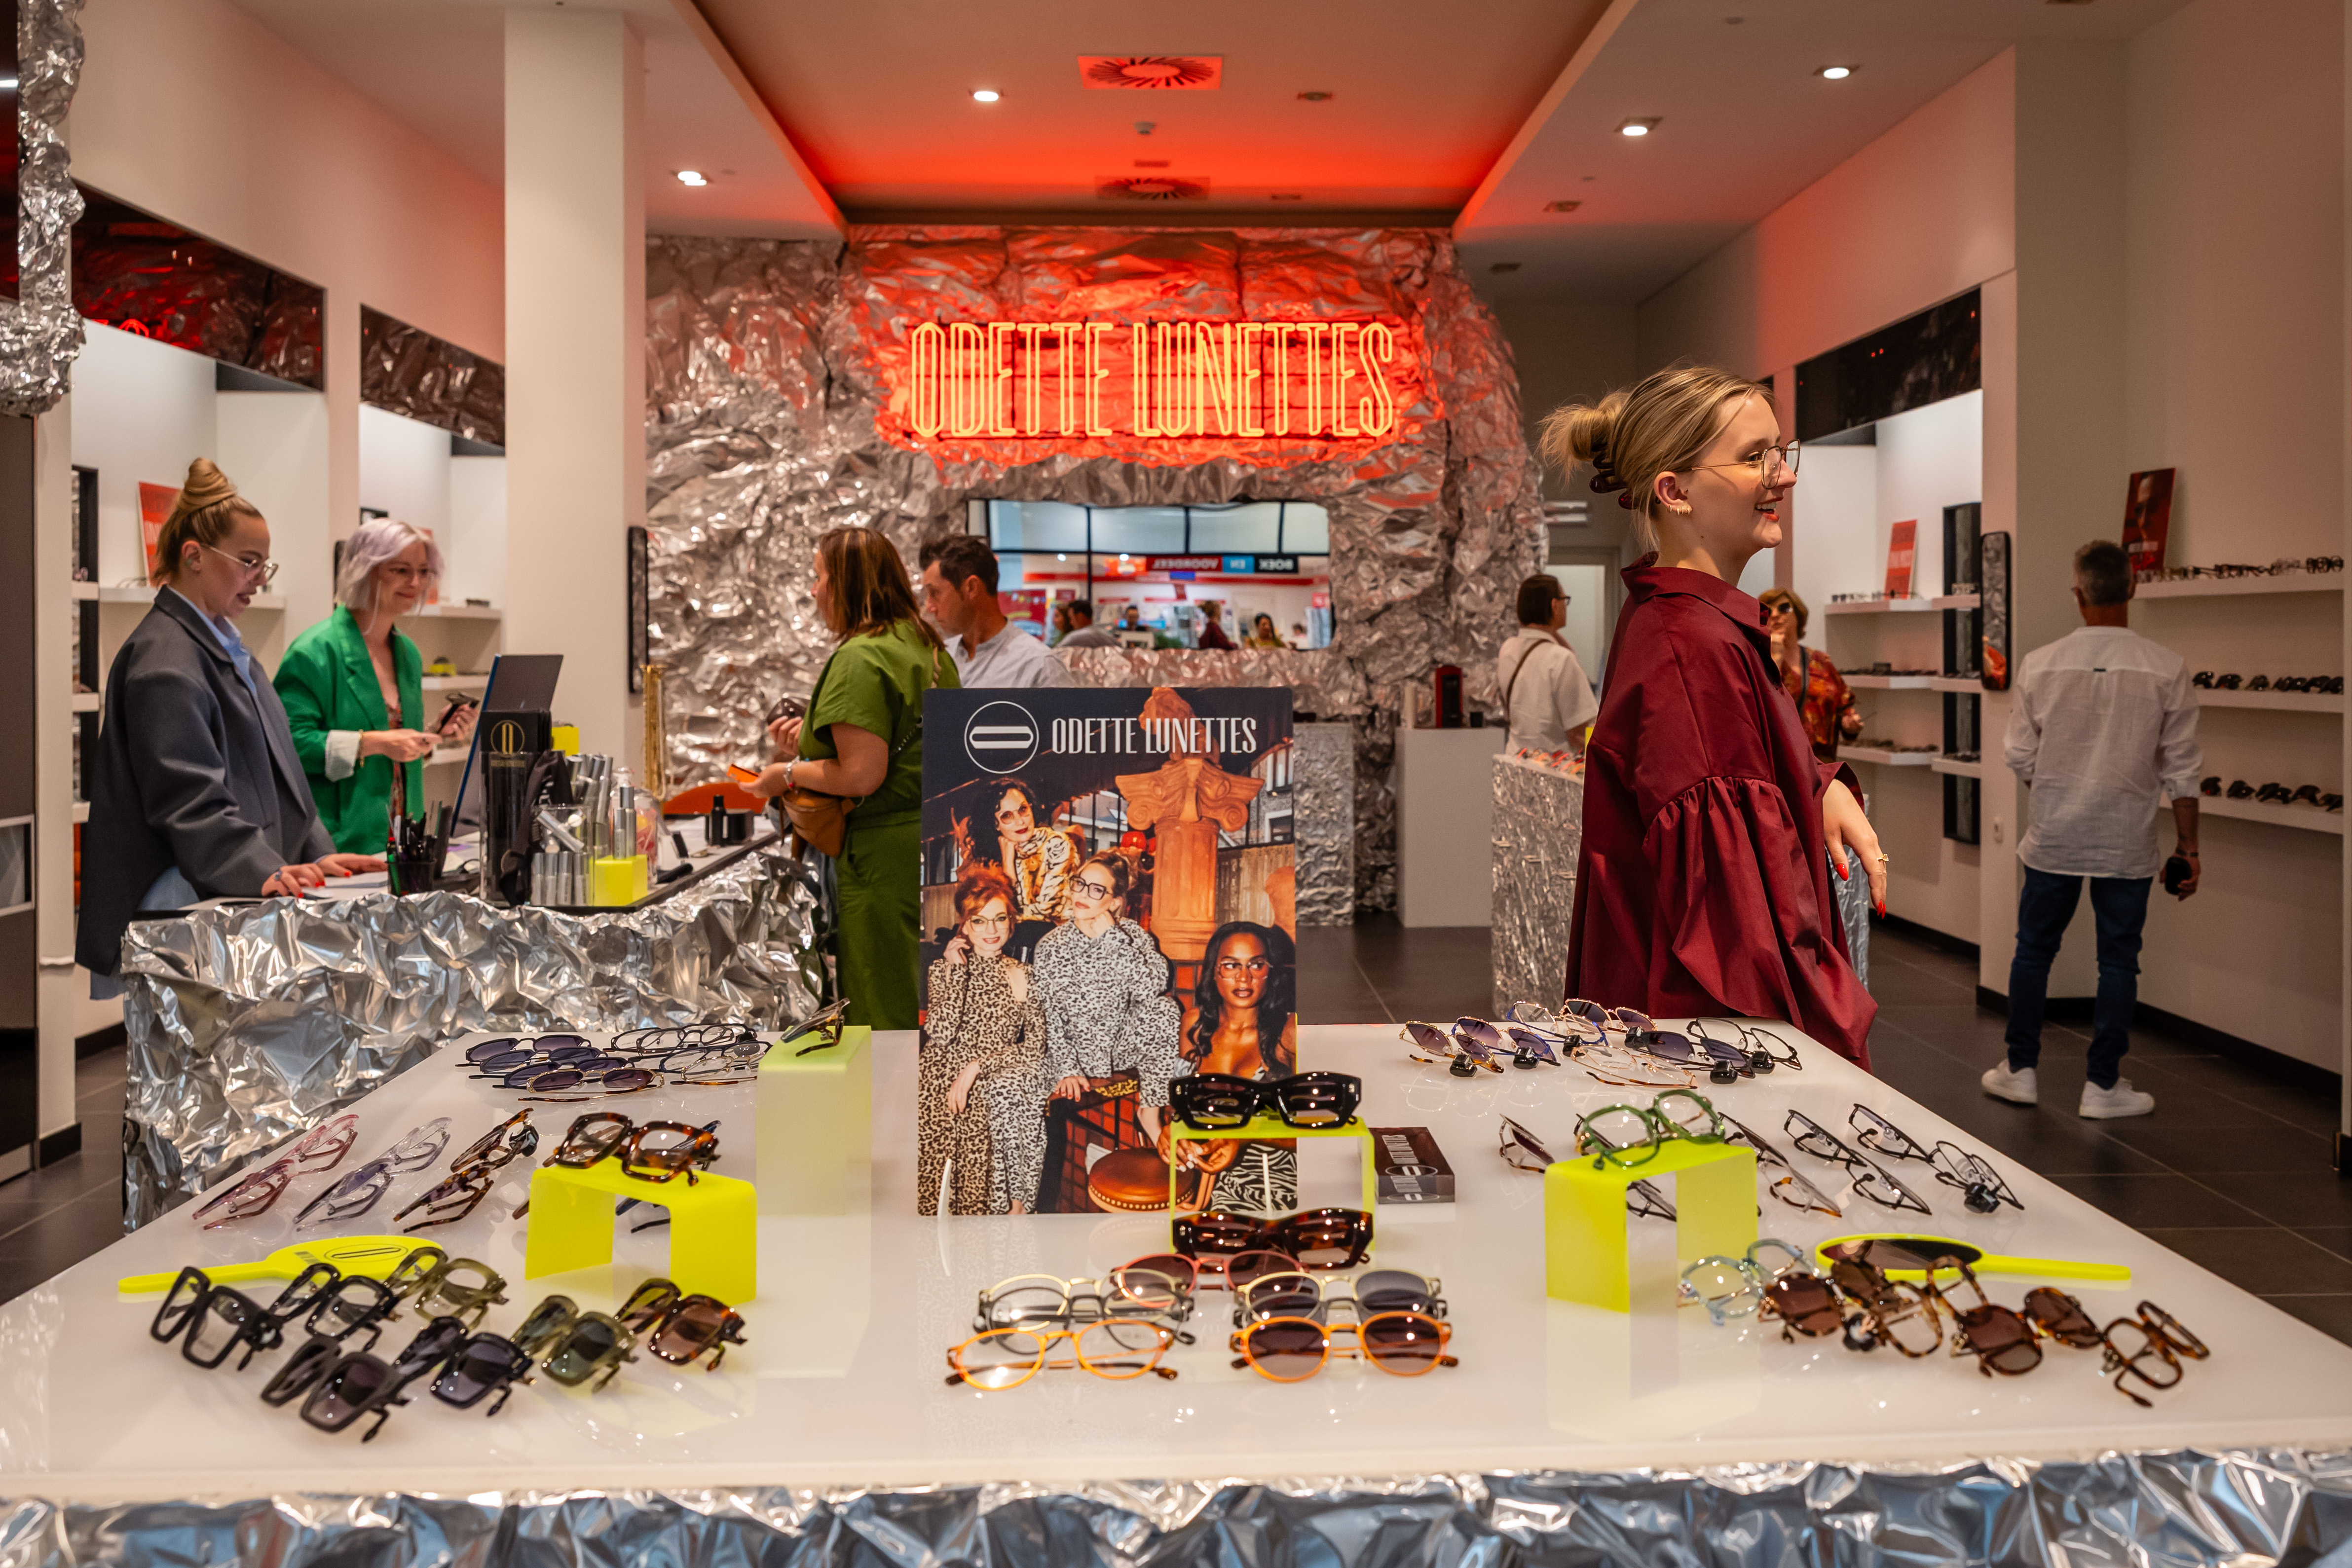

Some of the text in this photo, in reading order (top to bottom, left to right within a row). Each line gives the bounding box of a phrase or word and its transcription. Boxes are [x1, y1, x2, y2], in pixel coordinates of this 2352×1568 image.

[910, 321, 1393, 438] ODETTE LUNETTES
[1052, 717, 1257, 754] ODETTE LUNETTES
